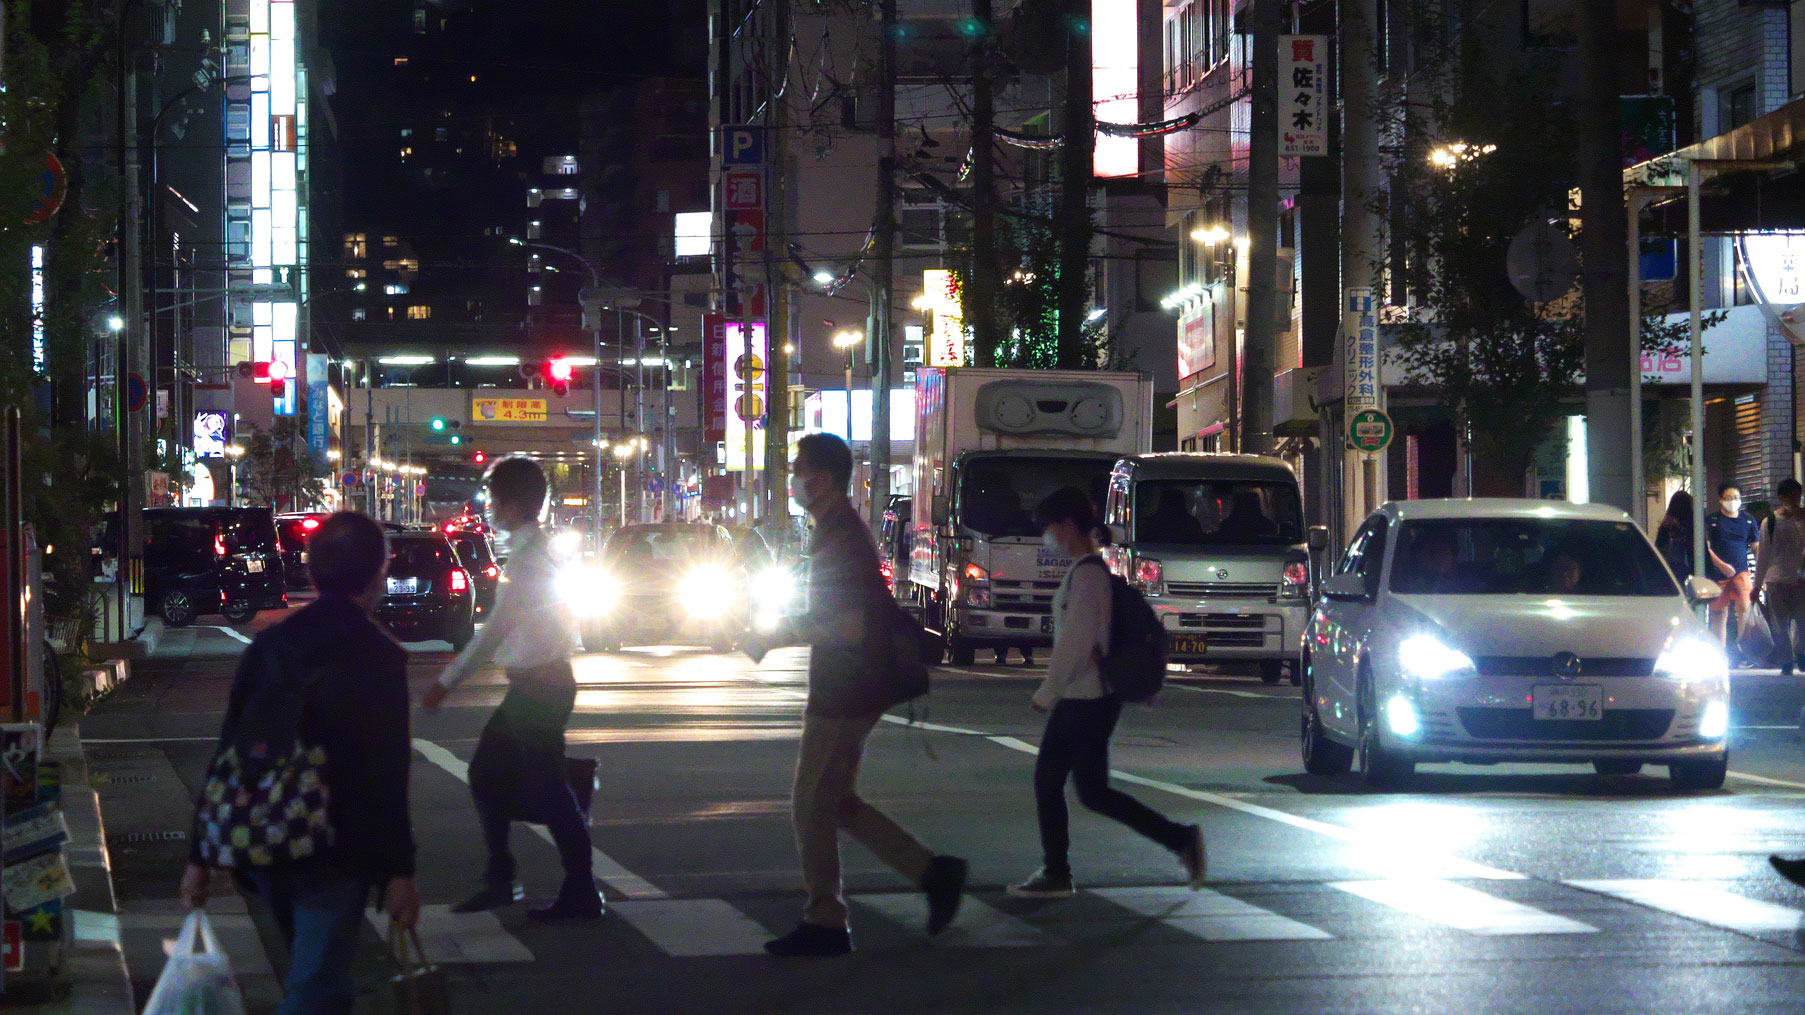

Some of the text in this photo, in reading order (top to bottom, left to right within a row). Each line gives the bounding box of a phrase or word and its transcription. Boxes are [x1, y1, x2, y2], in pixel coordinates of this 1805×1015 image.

[1291, 39, 1314, 62] 質
[1292, 67, 1314, 131] 佐々木
[733, 131, 753, 159] P
[731, 177, 757, 204] 酒
[1346, 335, 1358, 395] クリニック
[1358, 314, 1374, 396] 高倉整形外科
[312, 387, 324, 448] みなと銀行
[503, 410, 540, 419] 4.3m
